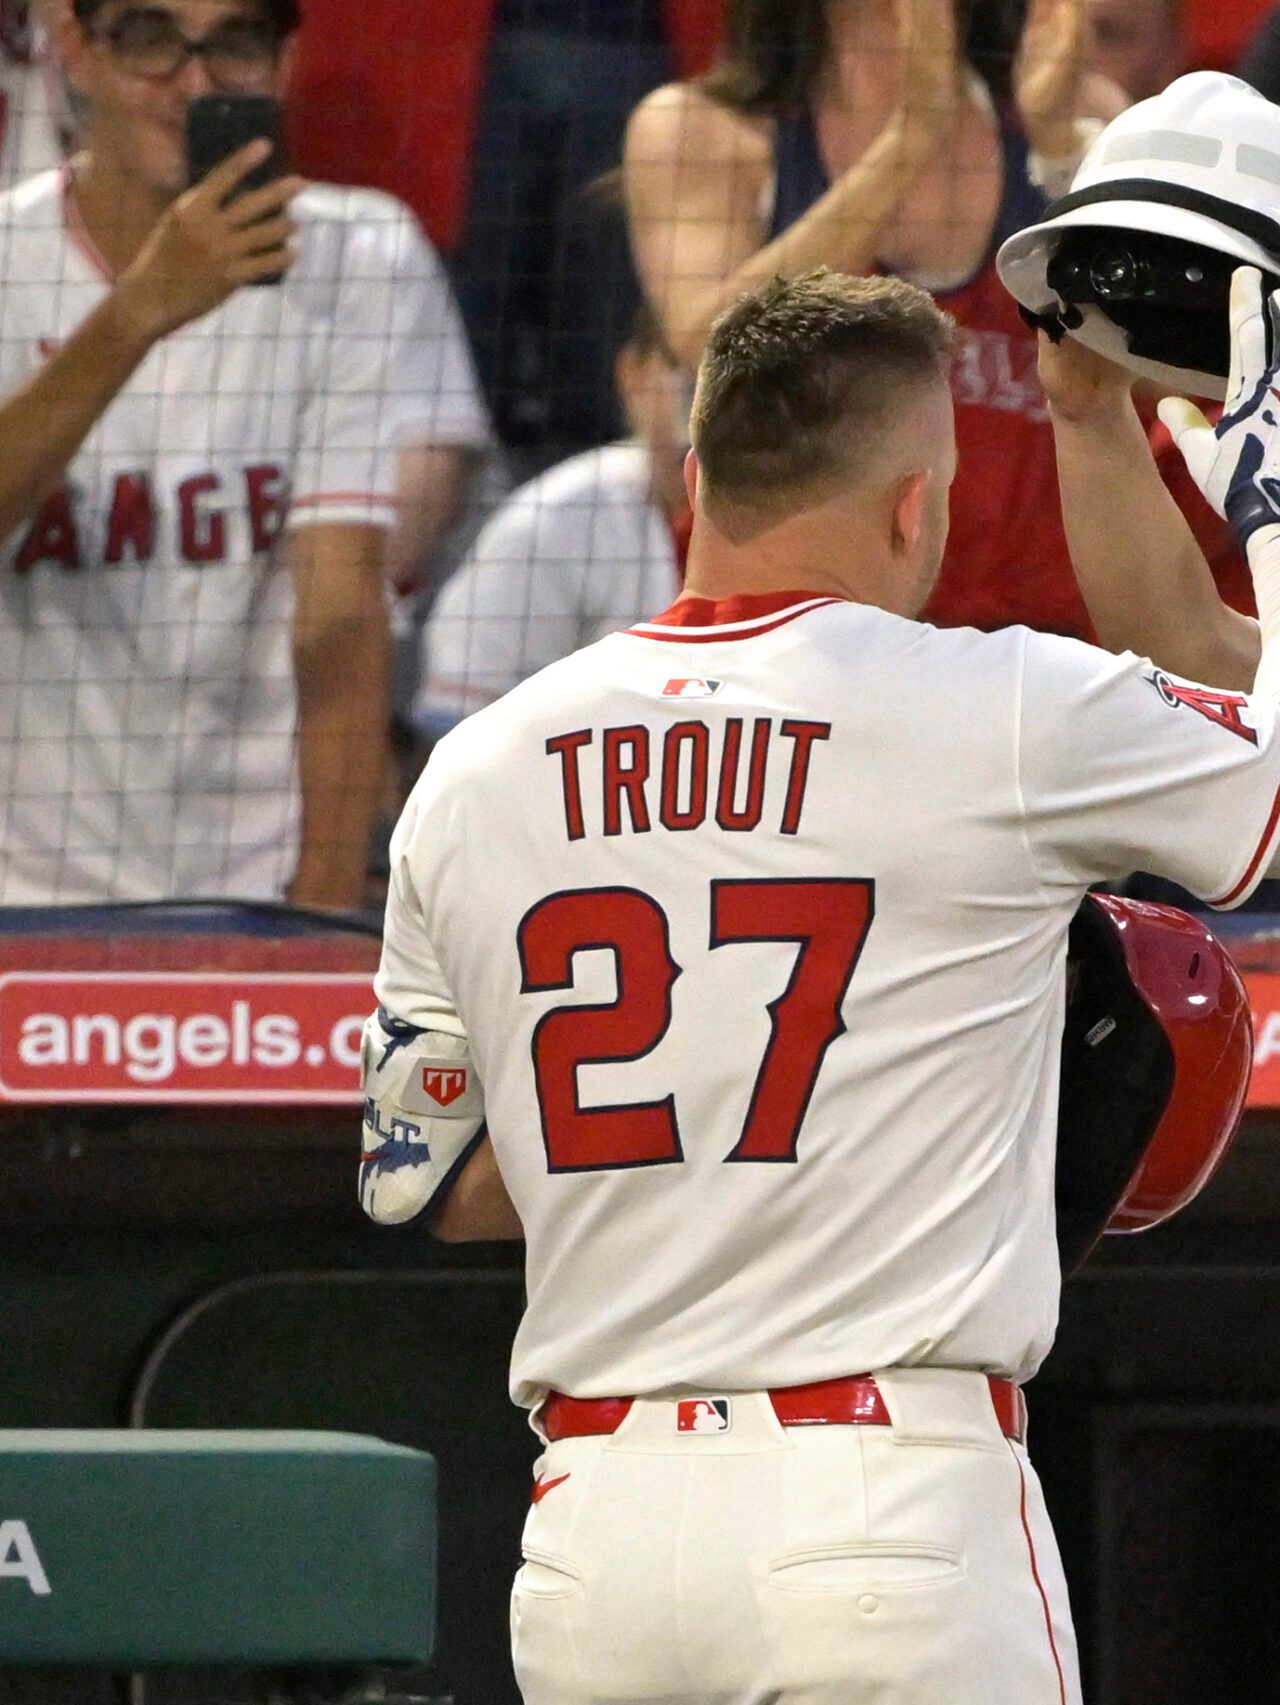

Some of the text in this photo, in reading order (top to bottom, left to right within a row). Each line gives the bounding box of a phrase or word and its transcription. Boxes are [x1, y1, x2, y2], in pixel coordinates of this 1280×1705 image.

[1142, 670, 1259, 748] A
[546, 717, 832, 841] TROUT
[516, 877, 876, 1174] 27
